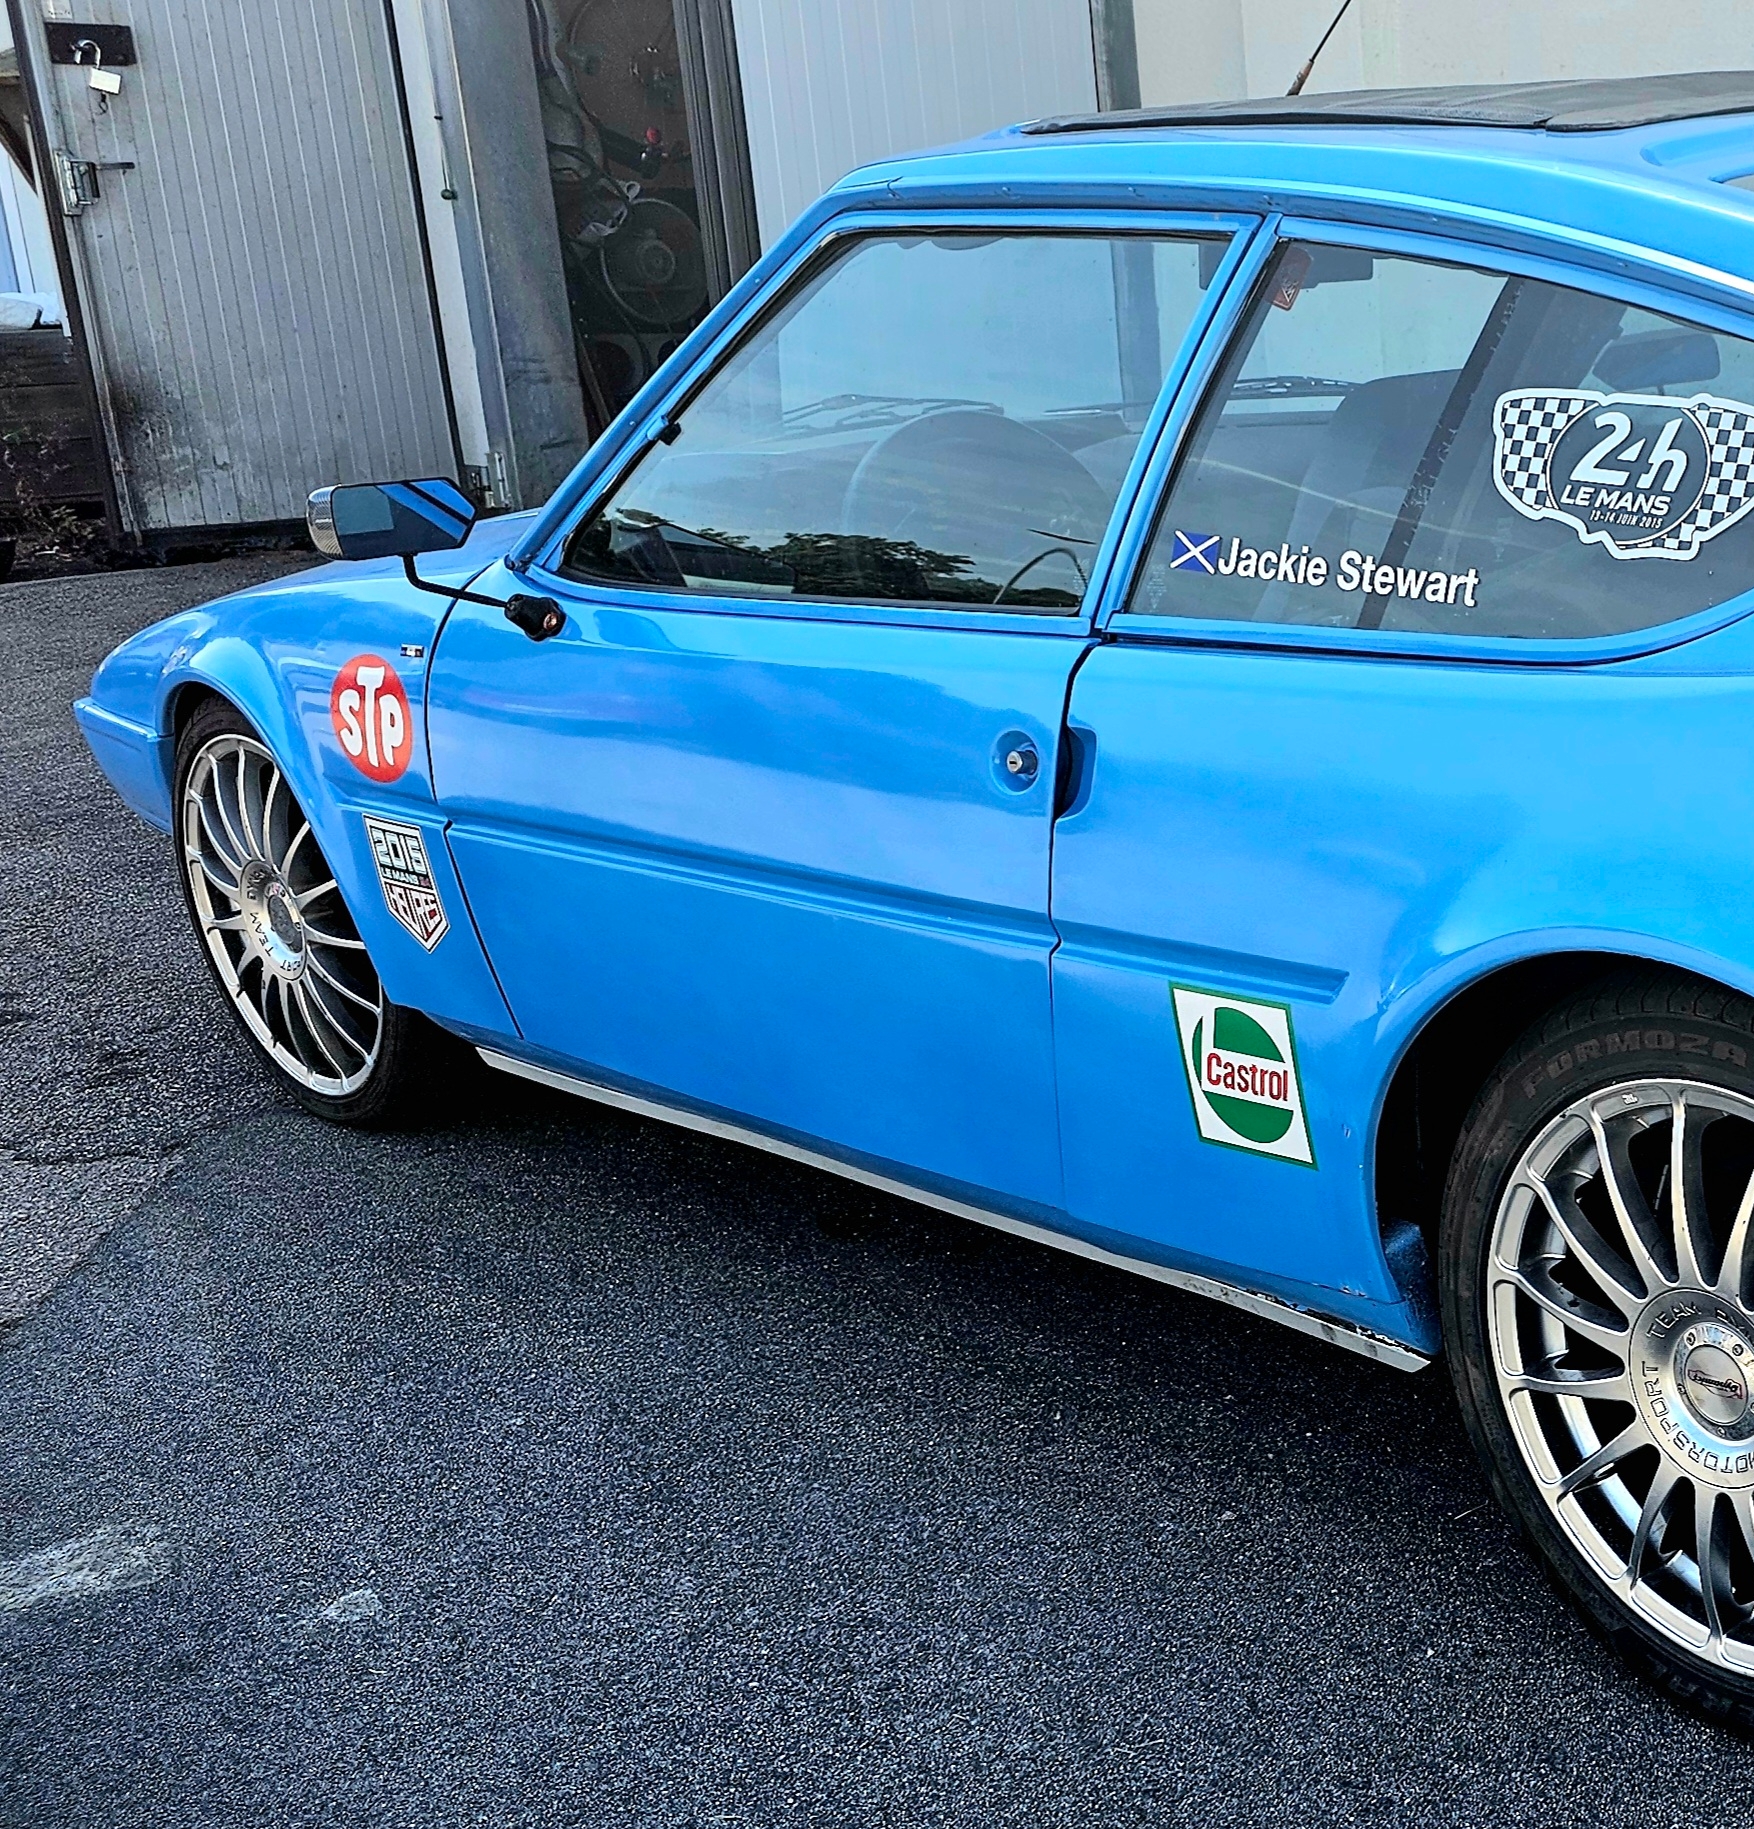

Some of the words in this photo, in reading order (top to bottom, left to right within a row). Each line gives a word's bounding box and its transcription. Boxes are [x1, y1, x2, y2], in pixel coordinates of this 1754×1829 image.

[1569, 411, 1688, 492] 24h
[1560, 484, 1593, 507] LE
[1594, 491, 1671, 517] MANS
[1639, 515, 1664, 529] 2015
[1217, 536, 1328, 587] Jackie
[1336, 549, 1480, 608] Stewart
[338, 665, 405, 768] STP
[1206, 1052, 1289, 1102] Castrol
[1522, 1028, 1748, 1099] FORMOZA
[1645, 1301, 1702, 1338] TEAM
